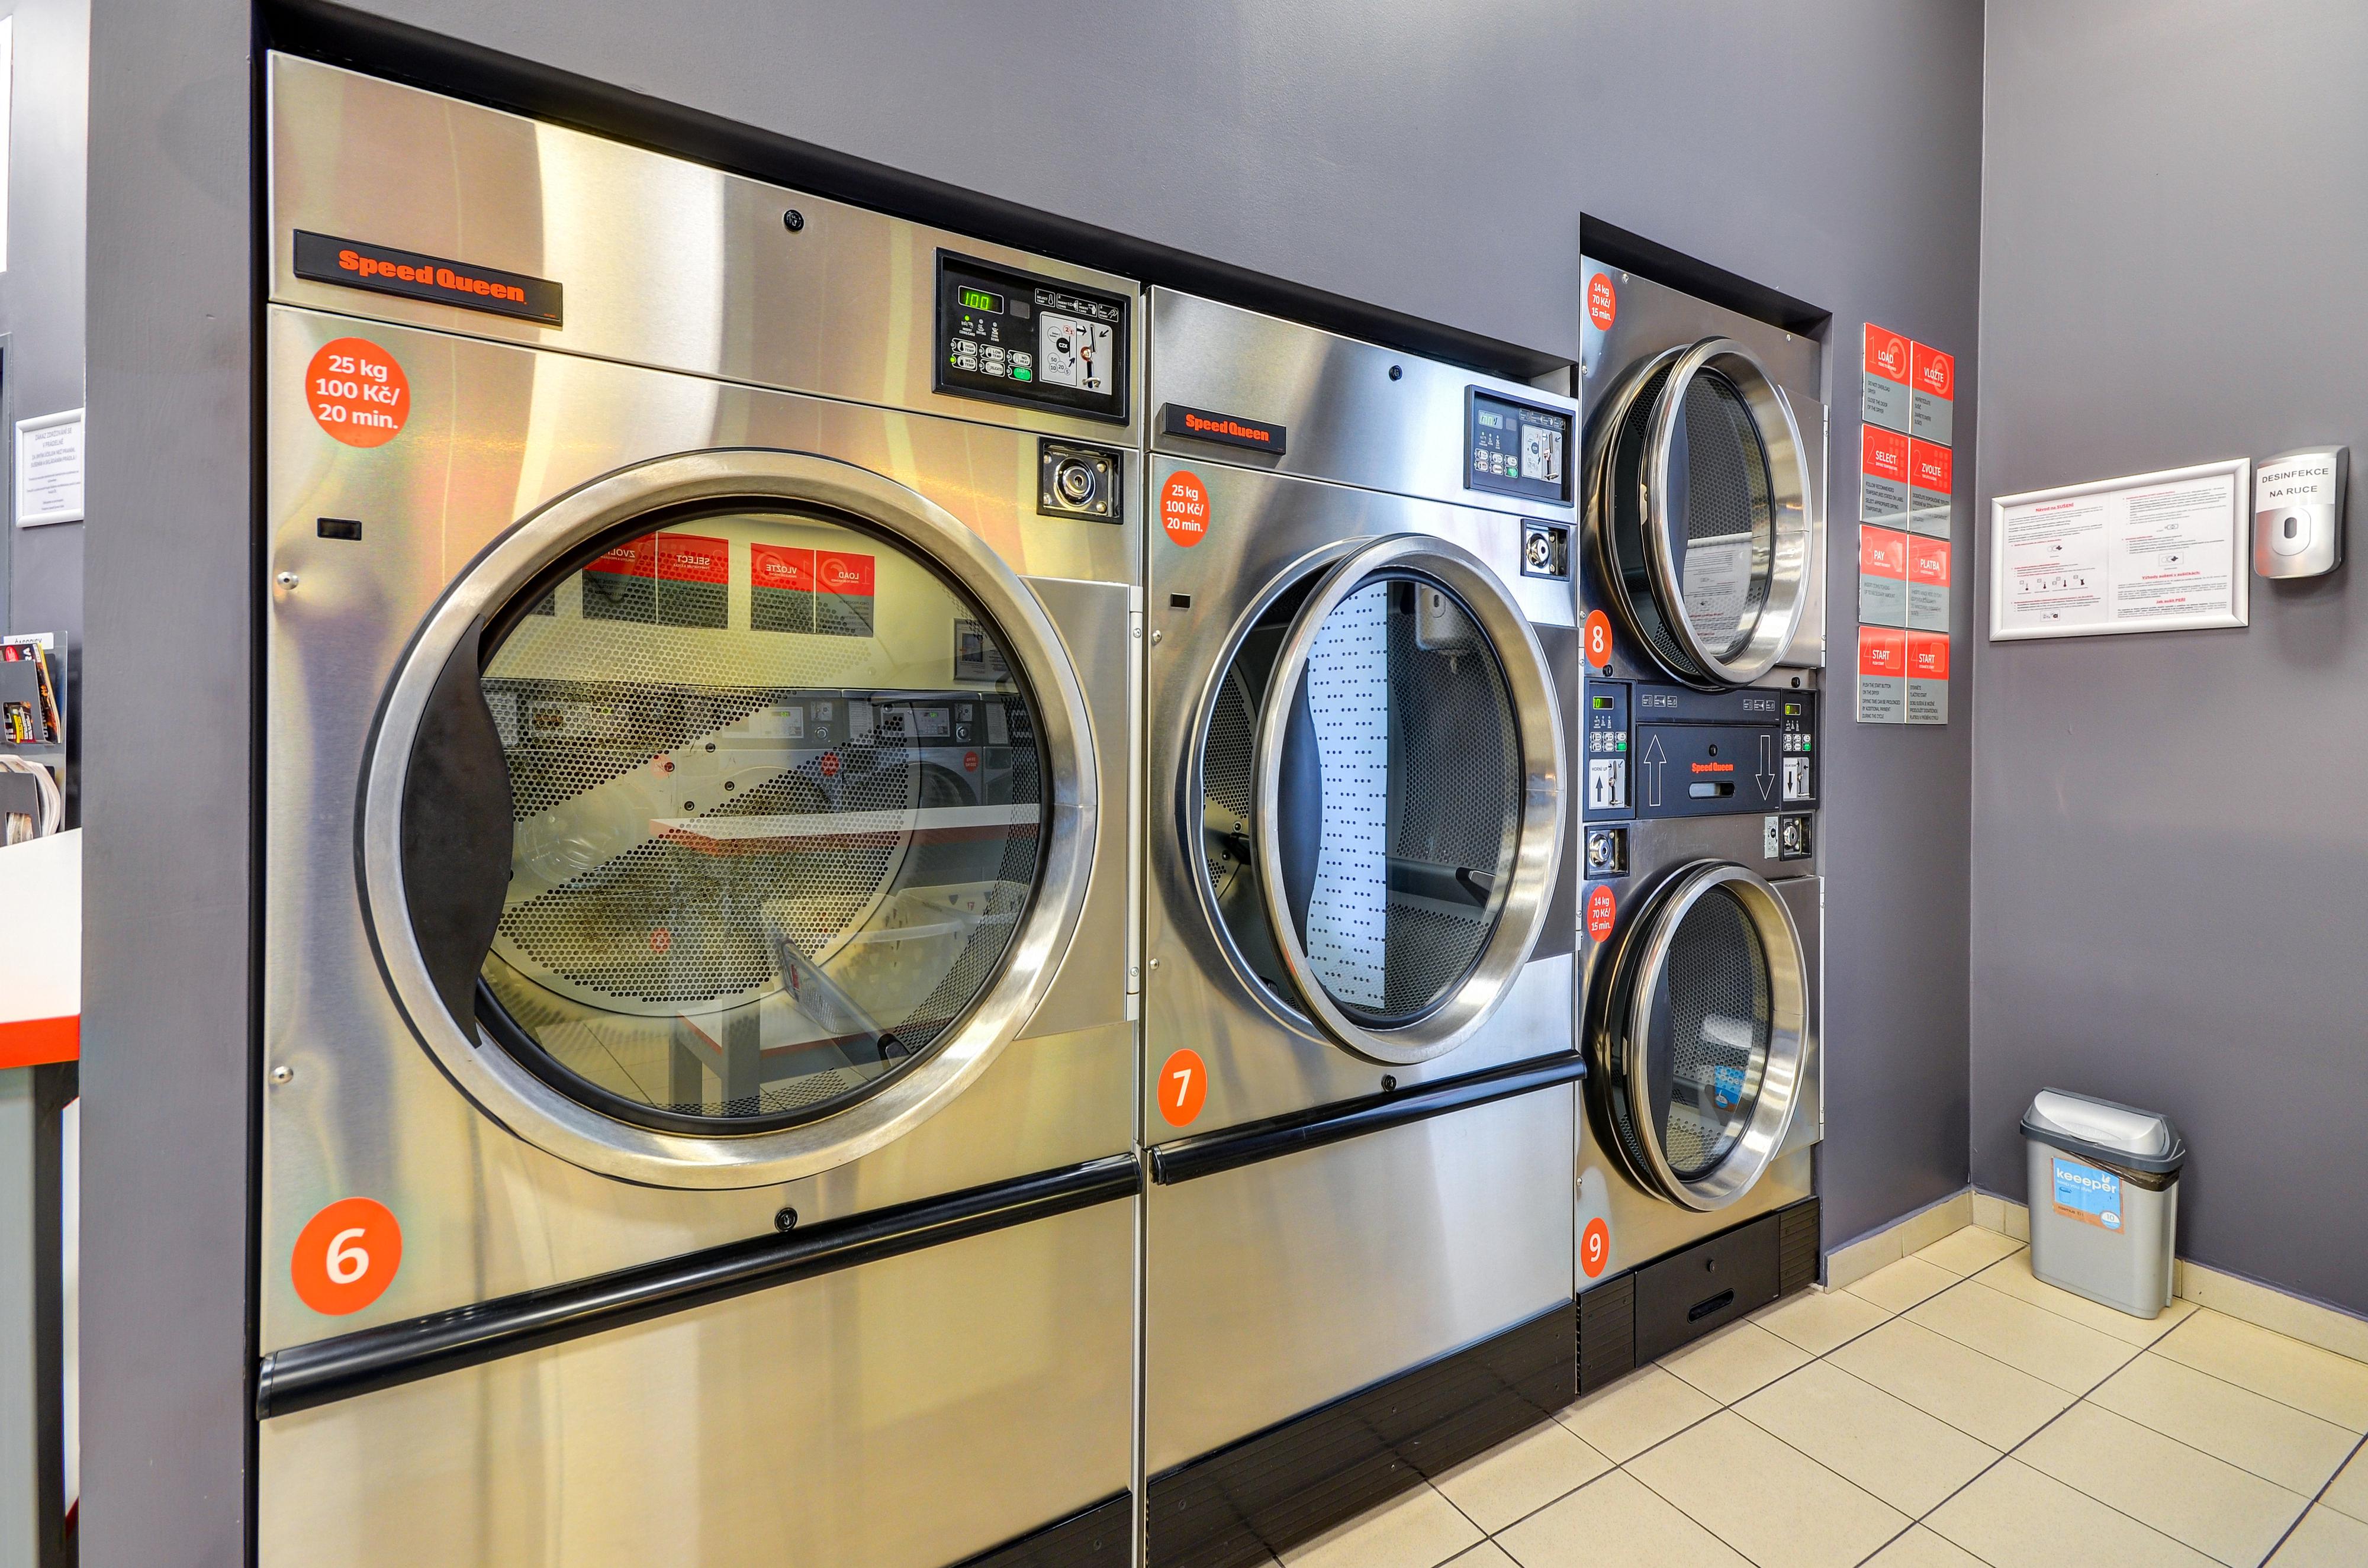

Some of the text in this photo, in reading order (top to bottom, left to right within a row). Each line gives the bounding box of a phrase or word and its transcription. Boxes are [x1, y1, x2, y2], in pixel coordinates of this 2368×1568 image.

[339, 249, 526, 304] Speed Queen
[1594, 283, 1610, 297] 14 kg
[965, 292, 989, 310] 100
[1592, 294, 1610, 308] 70 Kč/
[1591, 307, 1611, 321] 15 min.
[1878, 350, 1894, 364] LOAD
[328, 355, 388, 382] 25 kg
[1924, 366, 1944, 383] VLOŽTE
[316, 378, 400, 407] 100 Kč/
[318, 404, 399, 430] 20 min.
[1186, 414, 1270, 442] Speed Queen
[1867, 436, 1875, 464] 2
[1875, 450, 1897, 464] SELECT
[1922, 463, 1941, 476] ZVOLTE
[2262, 468, 2330, 483] DESINFEKCE
[1172, 484, 1199, 501] 25 kg
[2270, 485, 2318, 498] NA RUCE
[1166, 501, 1204, 516] 100 Kč/
[1167, 517, 1203, 532] 20 min.
[1874, 549, 1885, 561] PAY
[1920, 558, 1940, 571] PLATBA
[1592, 625, 1604, 653] 8
[1872, 649, 1890, 660] START
[1919, 653, 1935, 664] START
[1691, 762, 1733, 773] Speed Queen
[1594, 896, 1610, 907] 14 kg
[1592, 907, 1610, 918] 70 Kč/
[1591, 921, 1611, 931] 15 min.
[1173, 1068, 1192, 1107] 7
[2057, 1167, 2117, 1193] keeeper
[1590, 1233, 1601, 1263] 9
[326, 1228, 369, 1284] 6
